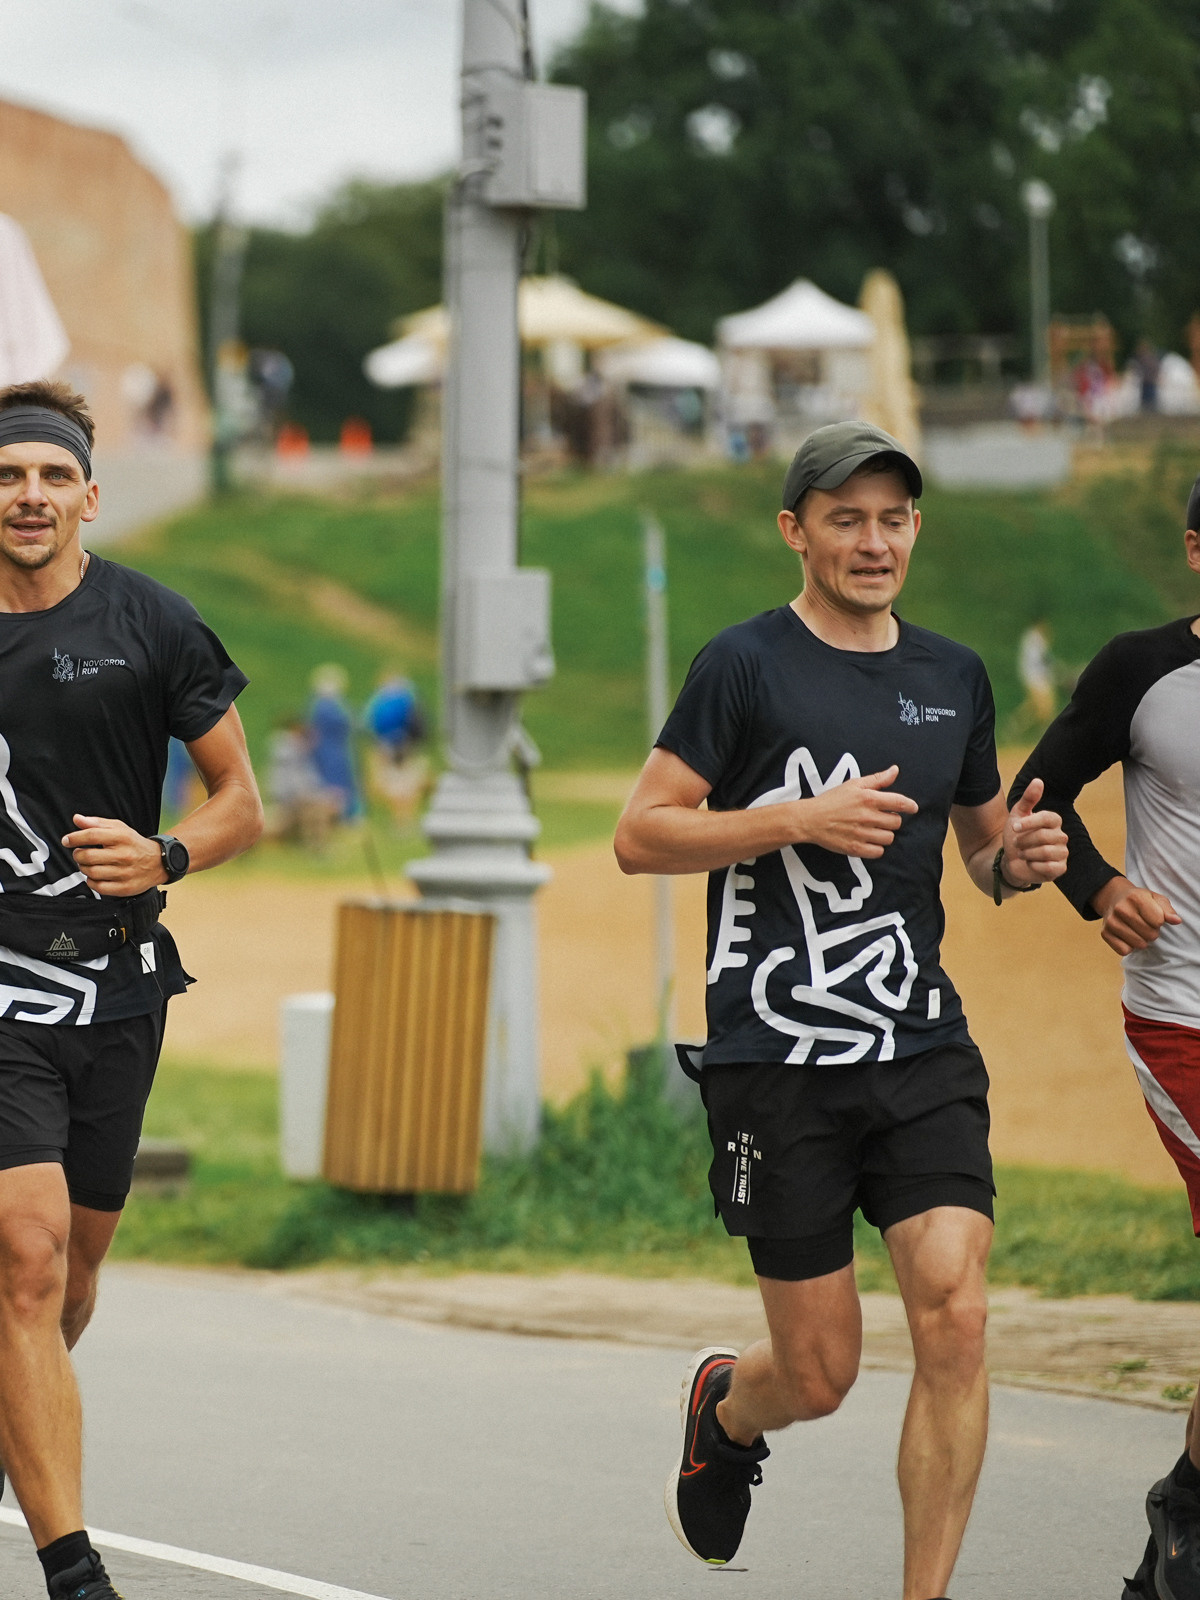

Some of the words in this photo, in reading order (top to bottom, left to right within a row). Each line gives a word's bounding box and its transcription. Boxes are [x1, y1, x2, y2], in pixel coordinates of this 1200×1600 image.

[83, 659, 125, 667] NOVGOROD
[925, 707, 956, 717] NOVGOROD
[741, 1133, 749, 1144] IN
[740, 1157, 748, 1172] WE
[737, 1174, 747, 1205] TRUST
